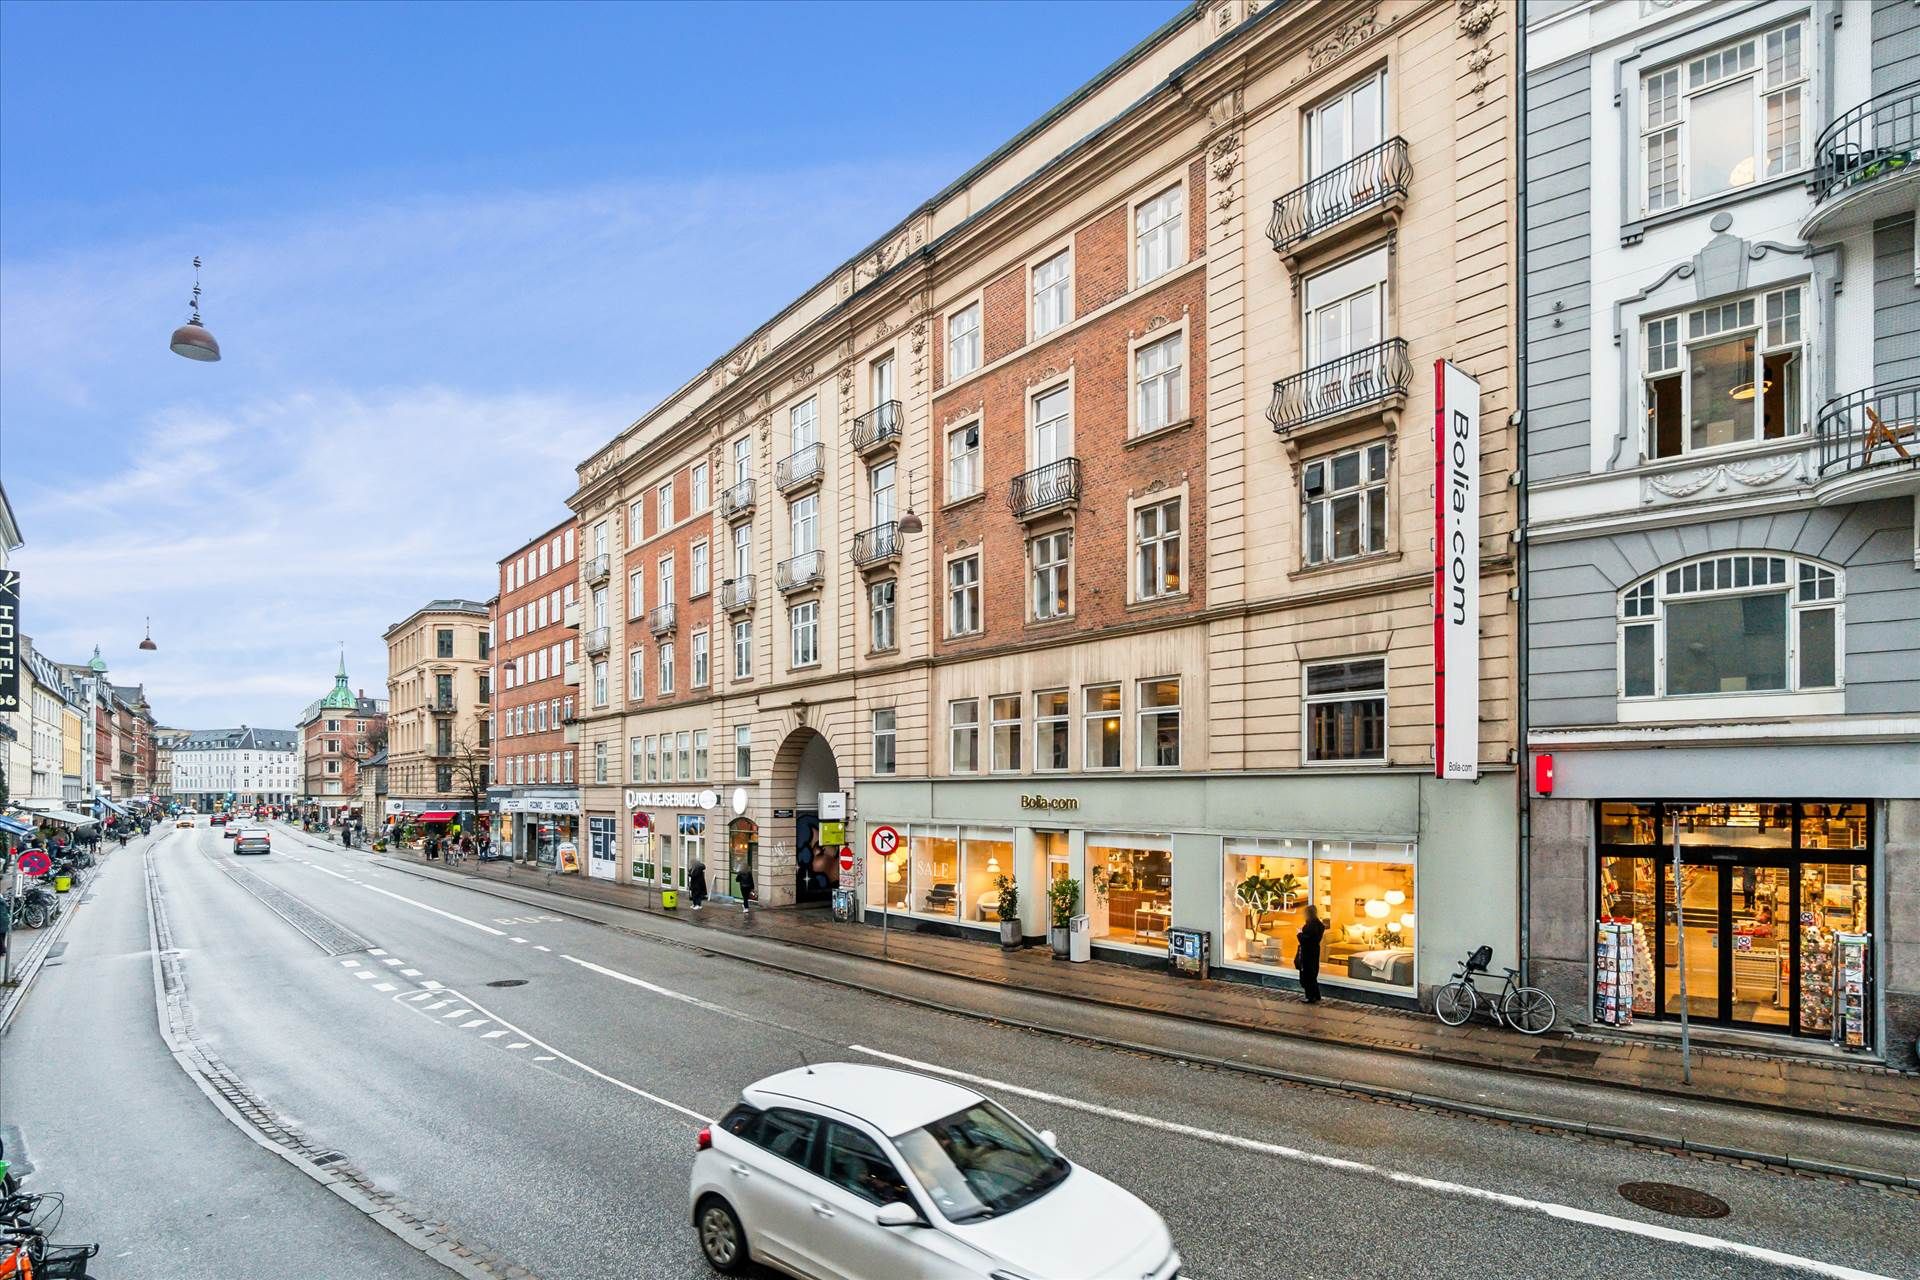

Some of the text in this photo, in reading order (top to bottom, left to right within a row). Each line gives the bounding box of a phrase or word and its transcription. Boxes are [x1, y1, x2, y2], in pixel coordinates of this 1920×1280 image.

[0, 605, 14, 685] HOTEL
[652, 792, 700, 808] REJSEBUREA
[918, 860, 949, 880] SALE
[1235, 887, 1296, 914] SALE
